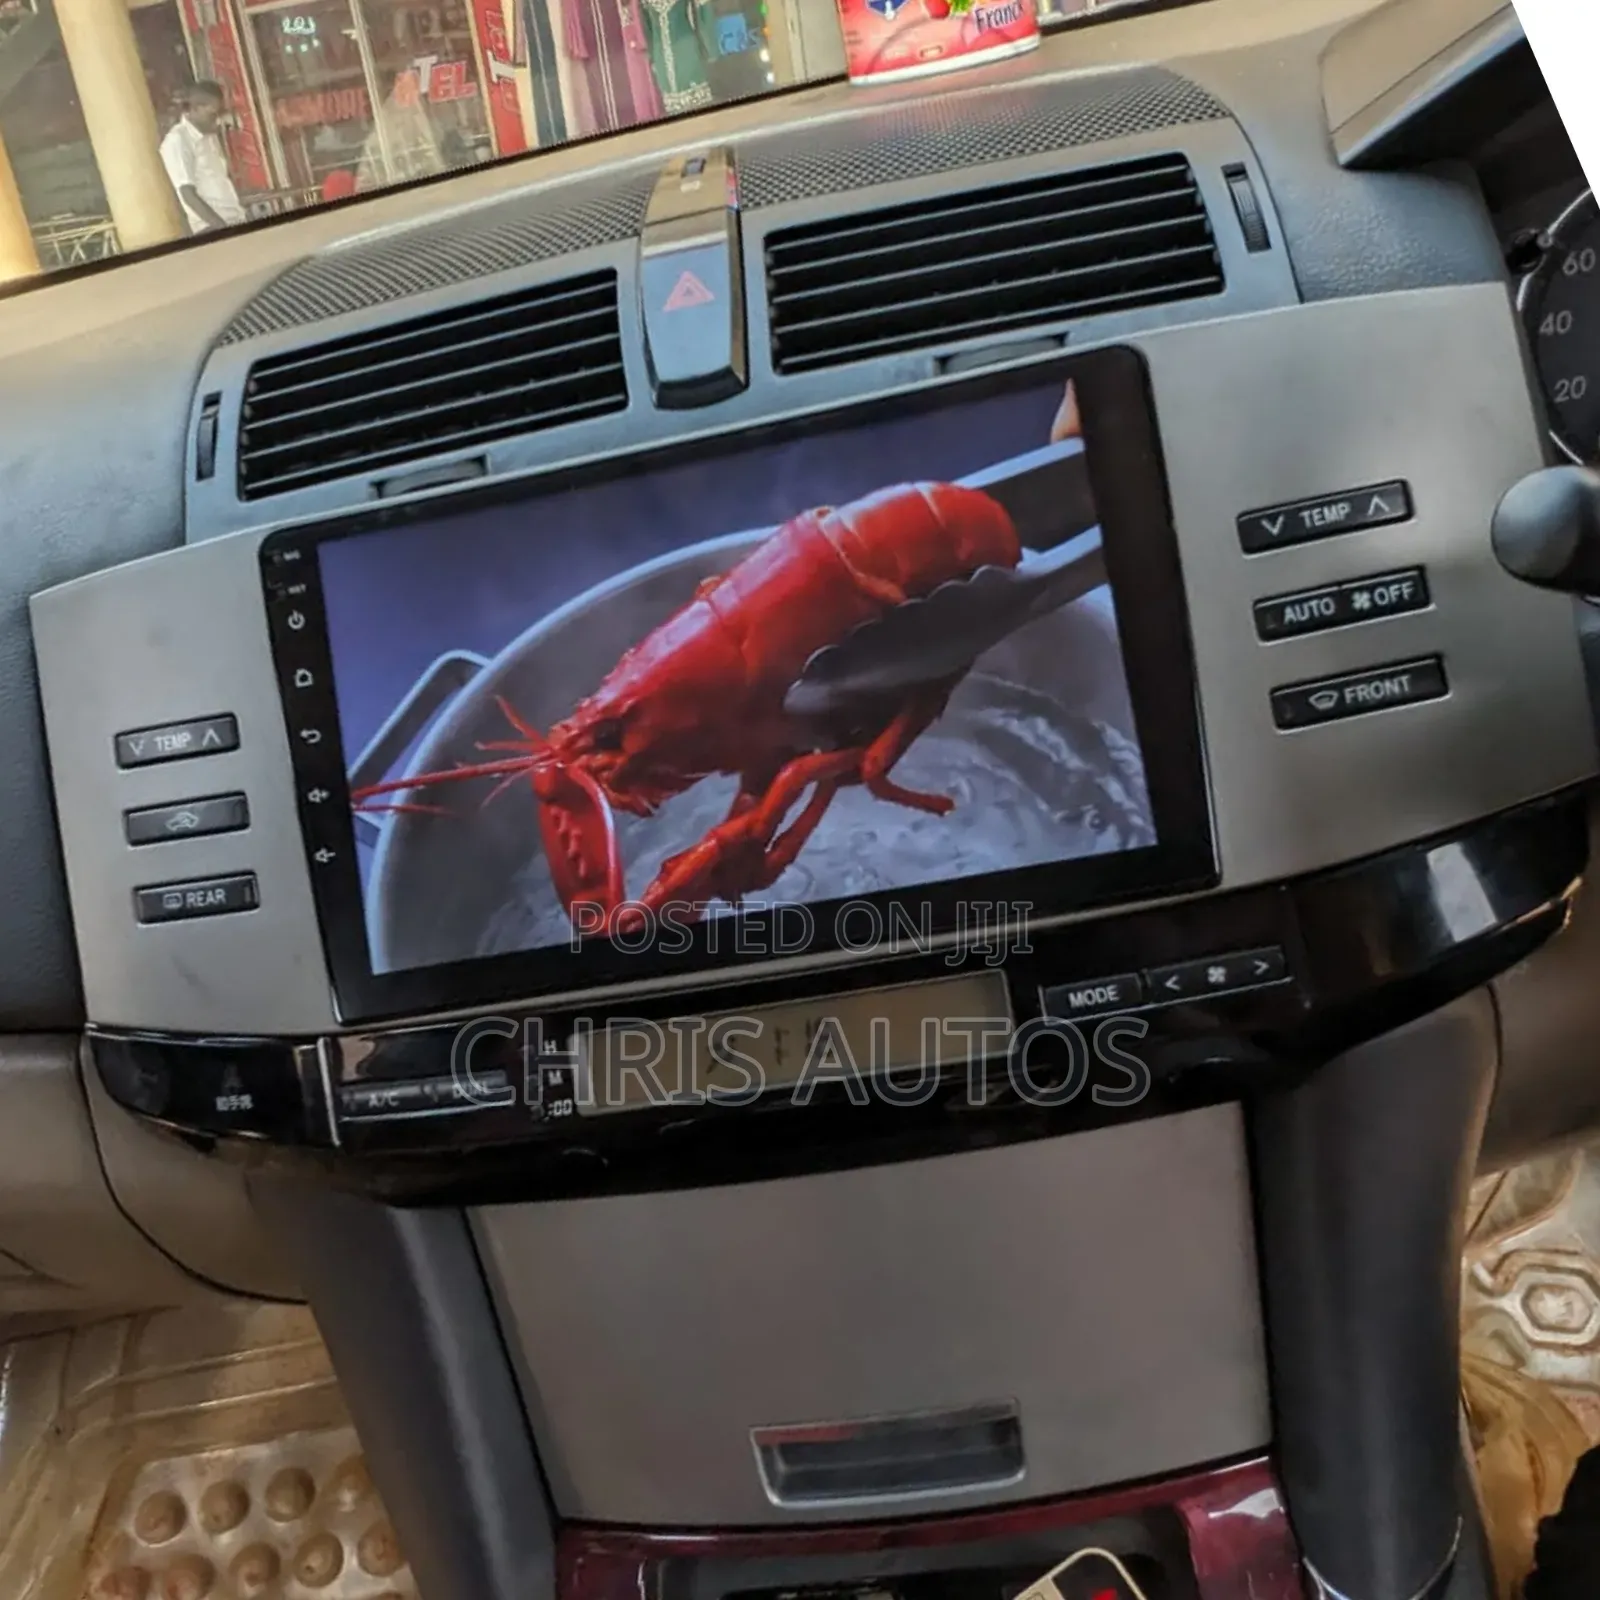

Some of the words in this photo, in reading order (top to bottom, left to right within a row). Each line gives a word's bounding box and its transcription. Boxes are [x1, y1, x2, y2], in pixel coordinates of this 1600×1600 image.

[1562, 248, 1596, 276] 60
[1539, 310, 1572, 335] 40
[1554, 375, 1587, 403] 20
[1299, 501, 1352, 530] TEMP
[1282, 597, 1336, 626] AUTO
[1373, 581, 1415, 608] OFF
[1343, 675, 1413, 706] FRONT
[153, 732, 193, 754] TEMP
[186, 888, 227, 909] REAR
[1068, 985, 1121, 1009] MODE
[544, 1040, 557, 1054] H
[548, 1070, 563, 1086] M
[368, 1091, 400, 1107] A/C
